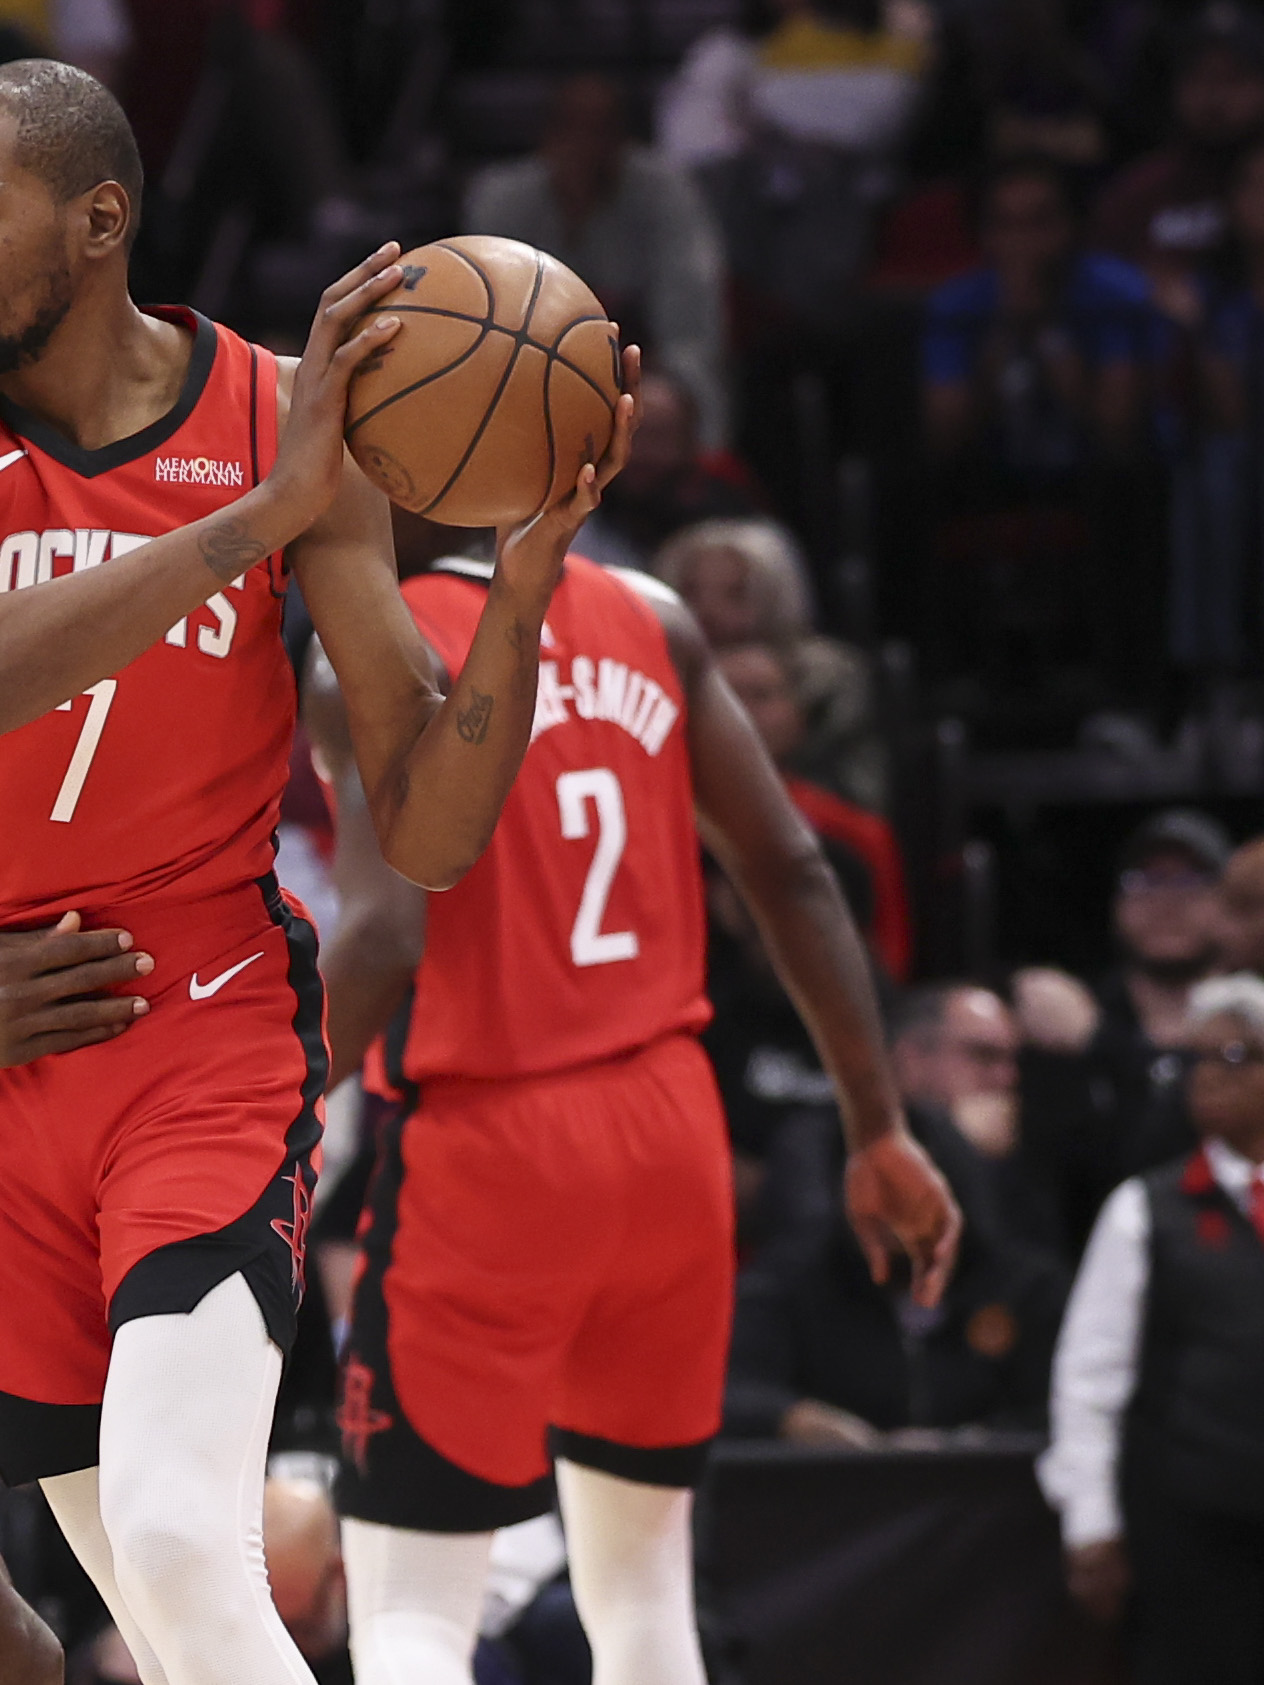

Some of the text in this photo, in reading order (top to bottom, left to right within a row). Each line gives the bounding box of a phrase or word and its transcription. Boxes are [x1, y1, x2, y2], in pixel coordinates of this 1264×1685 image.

[156, 457, 243, 475] MEMORIAL
[156, 469, 243, 486] HERMANN
[49, 679, 117, 823] 7
[556, 768, 639, 967] 2
